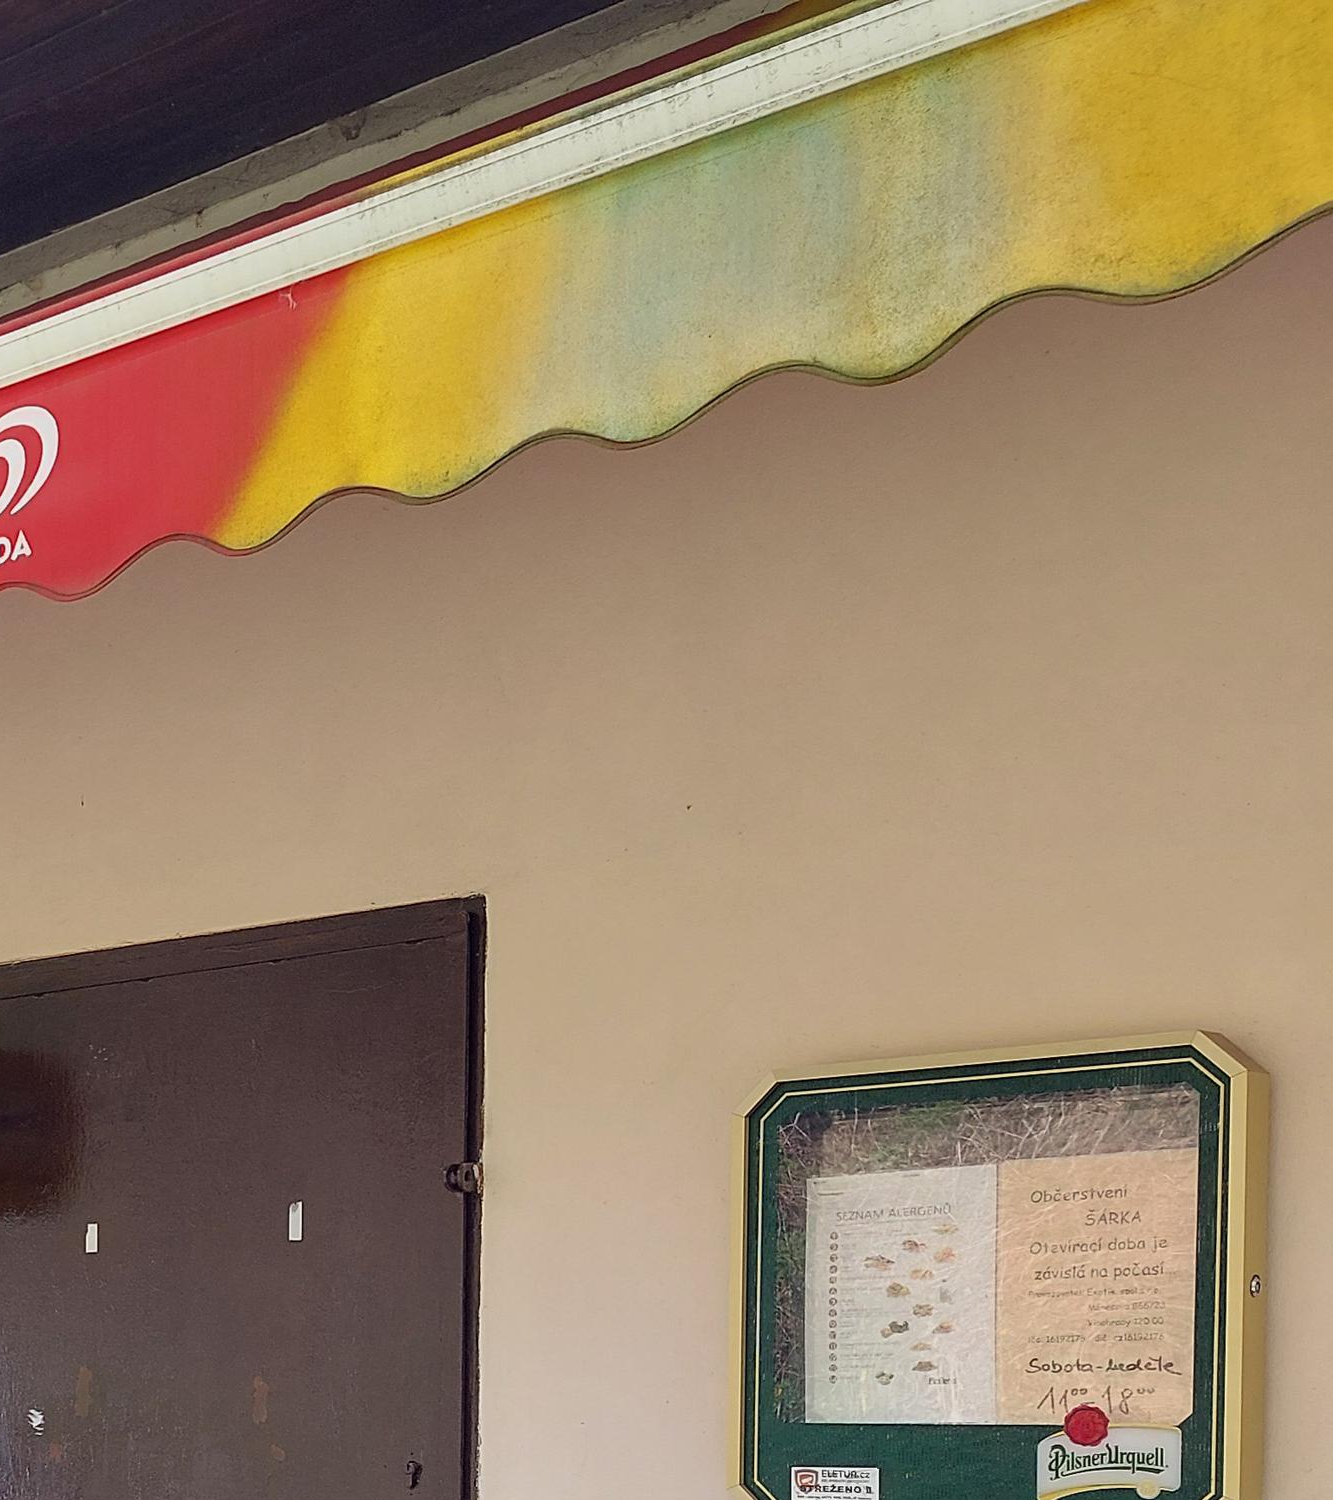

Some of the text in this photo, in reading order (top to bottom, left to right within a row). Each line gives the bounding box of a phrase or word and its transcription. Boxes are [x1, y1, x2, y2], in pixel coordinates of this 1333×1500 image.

[835, 1208, 885, 1222] SEZNAM
[1084, 1208, 1142, 1227] ŠÁRKA
[1107, 1237, 1146, 1251] doba
[1153, 1235, 1168, 1253] je
[1090, 1266, 1108, 1279] na
[1113, 1261, 1165, 1281] počasí
[1047, 1443, 1166, 1481] Pilsner Urquell
